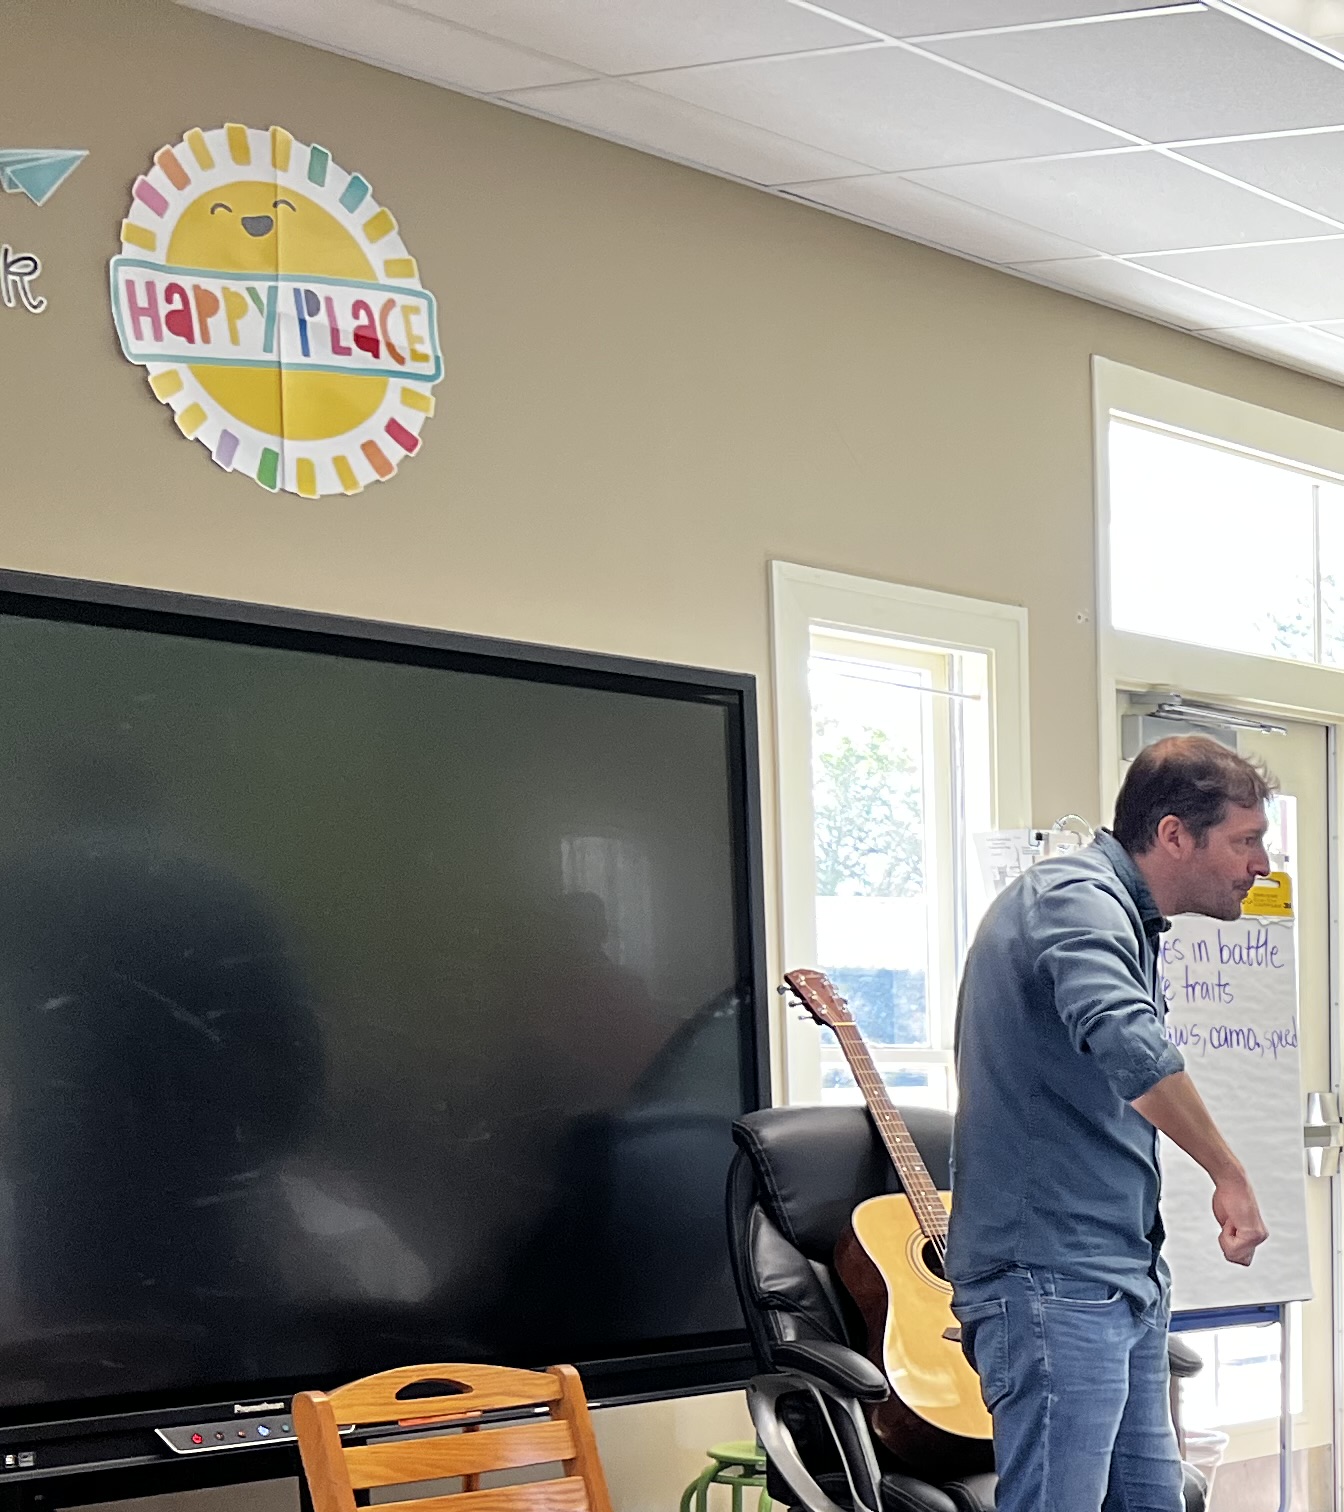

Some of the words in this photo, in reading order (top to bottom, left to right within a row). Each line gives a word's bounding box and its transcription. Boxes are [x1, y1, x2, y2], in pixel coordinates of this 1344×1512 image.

[1191, 939, 1210, 963] in
[1217, 927, 1285, 969] battle
[1181, 965, 1234, 1004] traits
